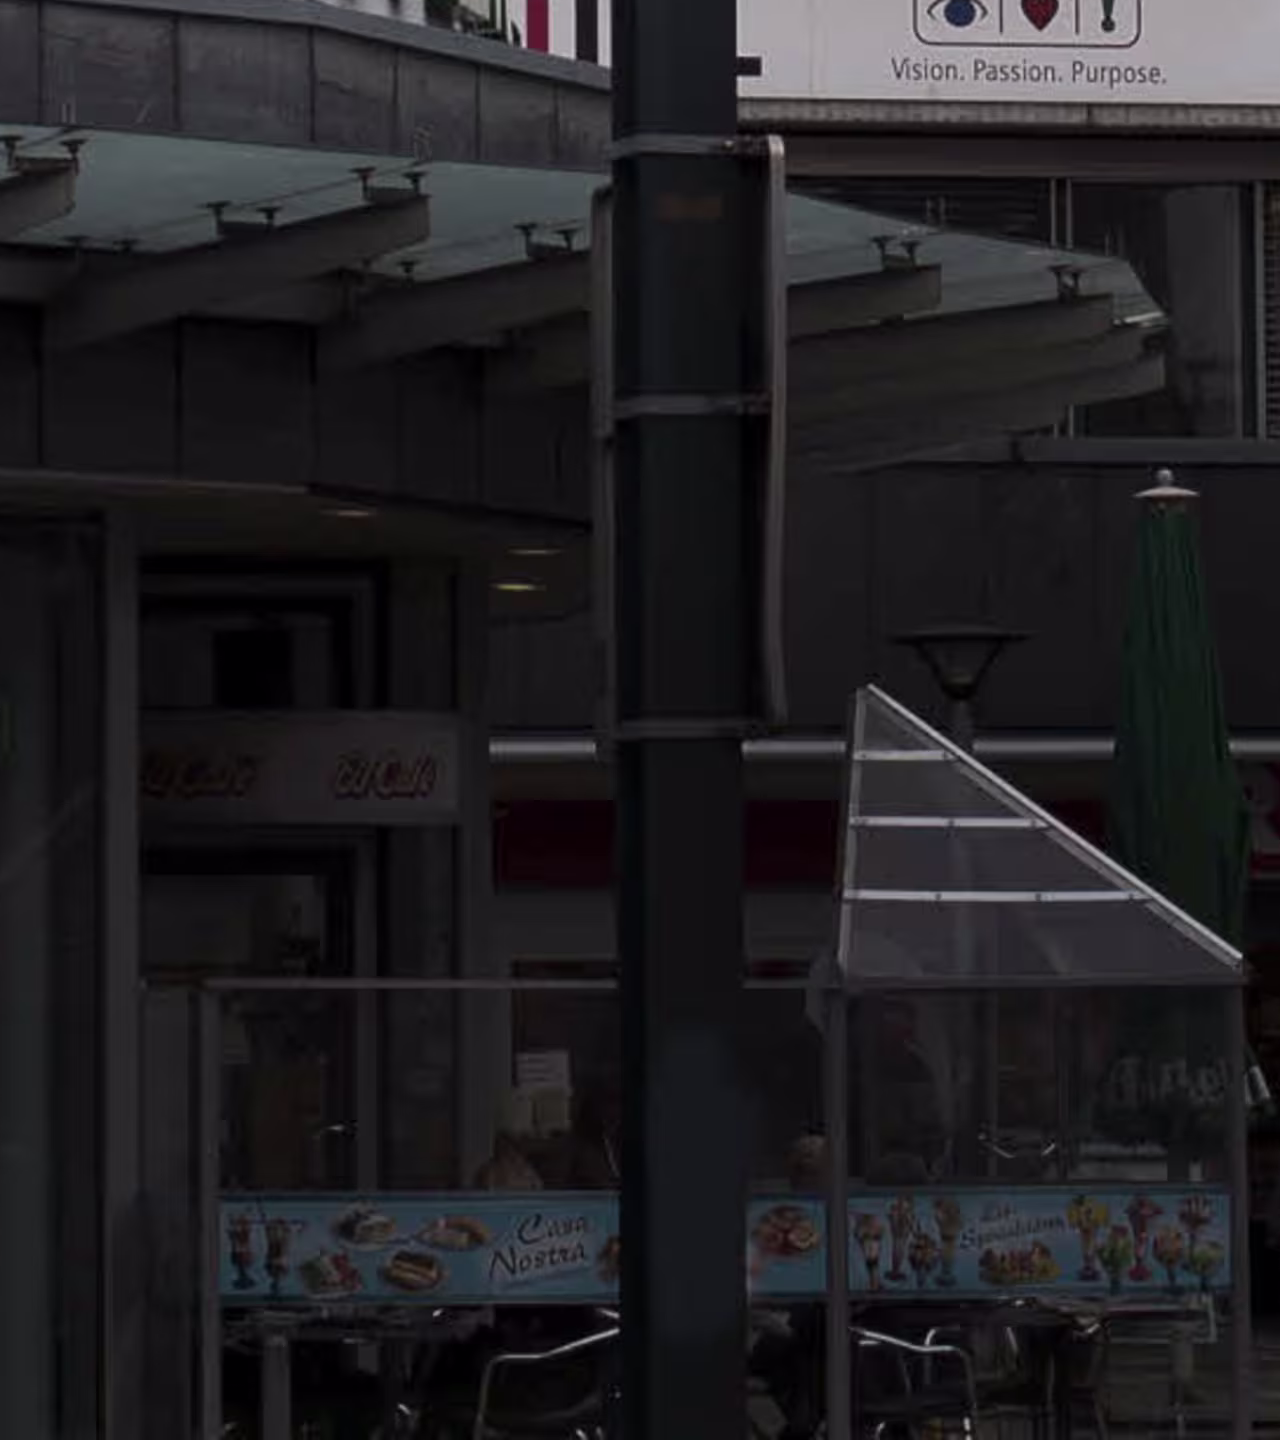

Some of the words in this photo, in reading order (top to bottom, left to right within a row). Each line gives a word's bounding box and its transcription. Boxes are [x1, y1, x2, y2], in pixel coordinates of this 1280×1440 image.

[890, 56, 965, 82] Vision.
[973, 58, 1062, 83] Passion.
[1071, 59, 1167, 90] Purpose.
